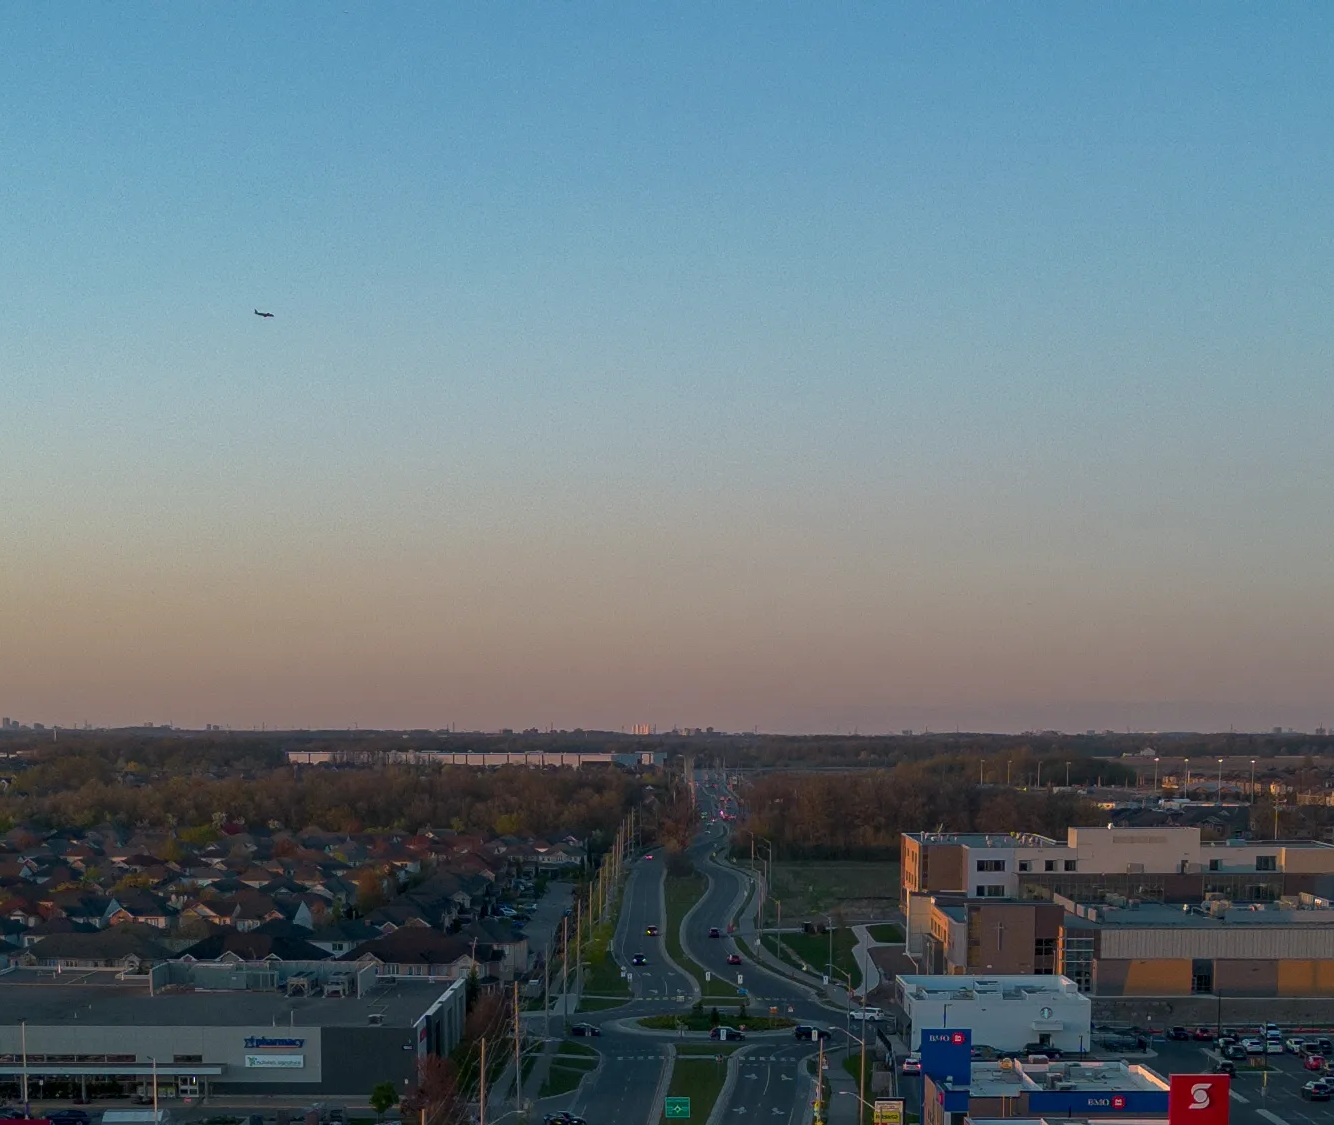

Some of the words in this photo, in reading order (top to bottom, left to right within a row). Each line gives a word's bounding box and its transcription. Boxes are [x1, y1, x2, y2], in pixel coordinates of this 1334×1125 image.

[929, 1034, 950, 1042] BMO
[255, 1036, 305, 1049] pharmacy
[1087, 1098, 1110, 1106] BMO
